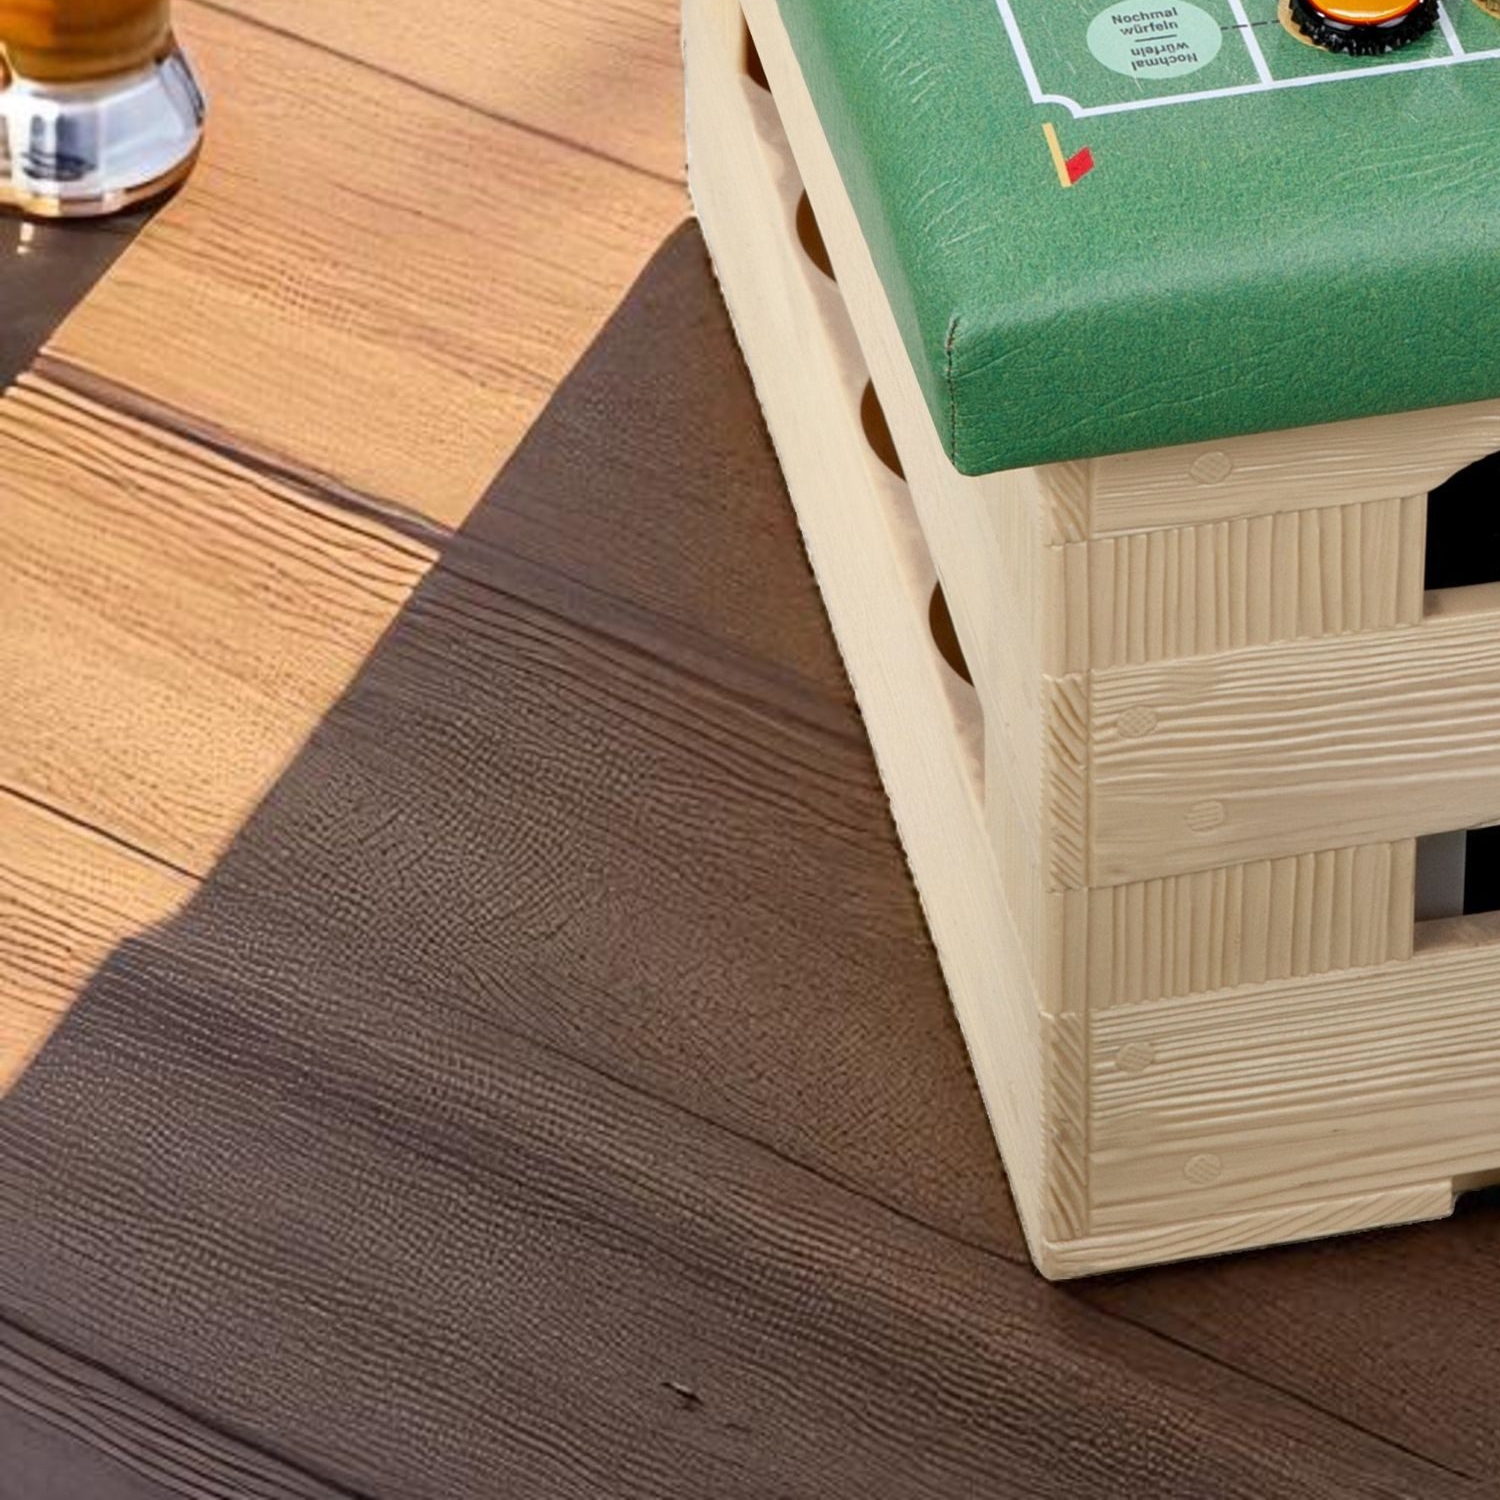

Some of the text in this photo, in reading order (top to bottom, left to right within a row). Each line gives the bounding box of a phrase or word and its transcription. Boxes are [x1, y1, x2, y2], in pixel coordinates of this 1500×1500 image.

[1111, 6, 1179, 25] Nochmal
[1120, 20, 1179, 36] würfeln
[1130, 41, 1190, 57] würfeln
[1131, 52, 1199, 72] Nochmal
